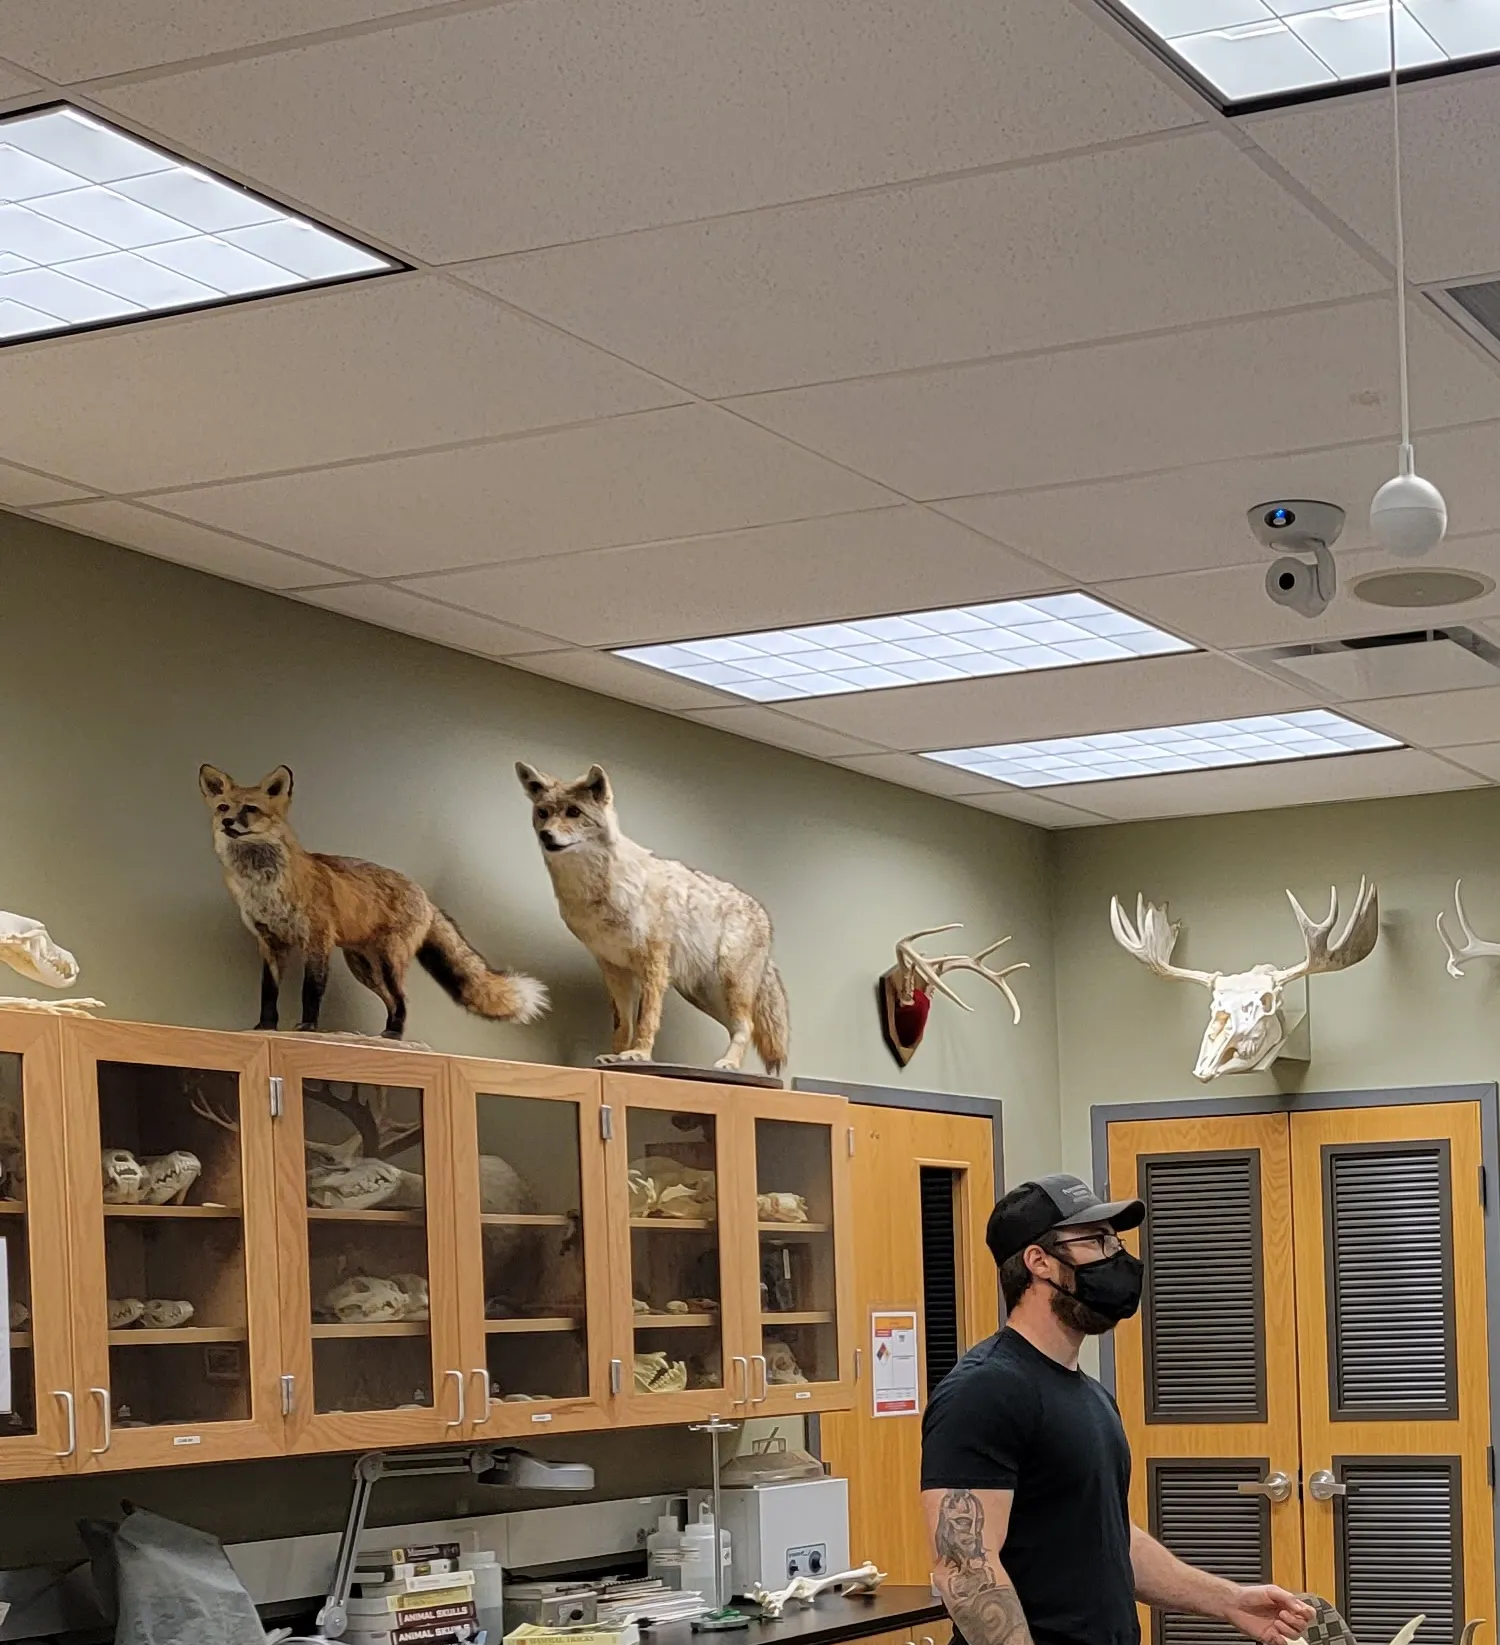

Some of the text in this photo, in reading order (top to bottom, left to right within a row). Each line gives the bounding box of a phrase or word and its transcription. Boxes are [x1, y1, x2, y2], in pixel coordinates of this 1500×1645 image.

[404, 1606, 468, 1622] ANIMAL SKULLS
[399, 1629, 434, 1642] ANIMAL
